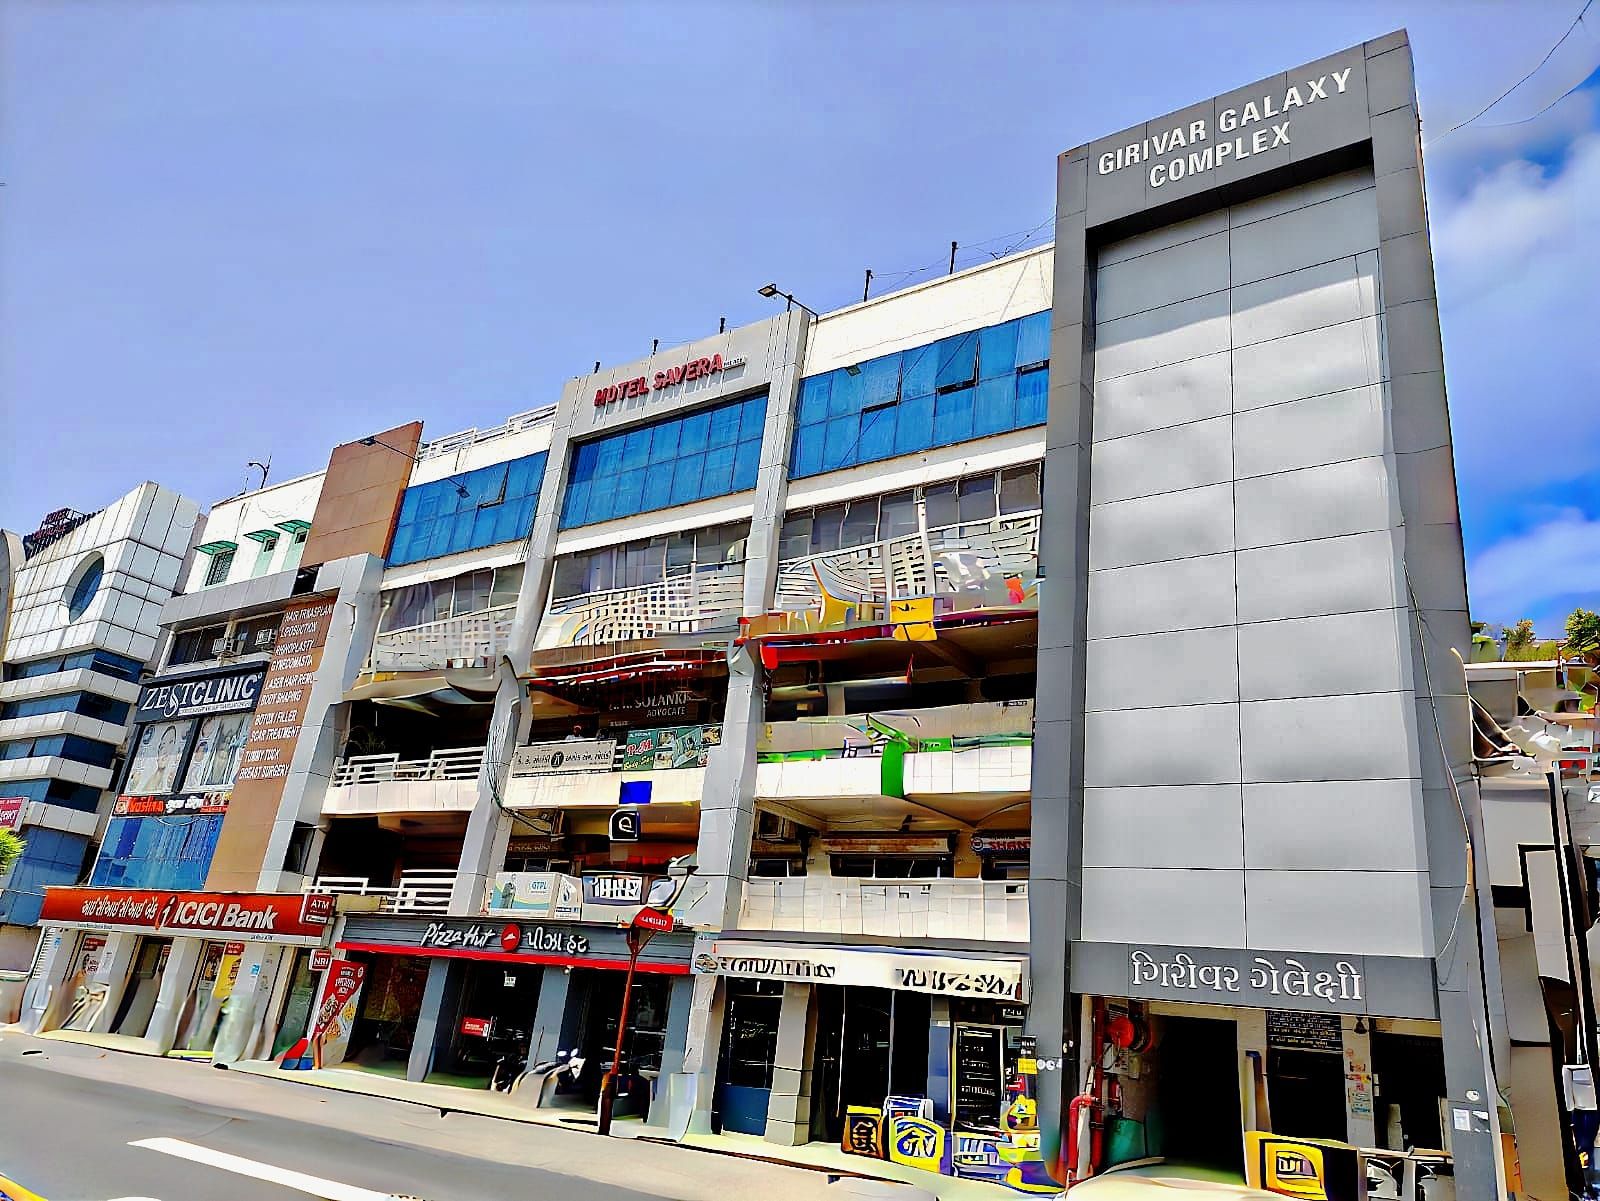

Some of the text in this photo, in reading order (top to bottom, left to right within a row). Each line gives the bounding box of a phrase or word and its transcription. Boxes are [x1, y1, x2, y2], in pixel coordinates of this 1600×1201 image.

[1099, 67, 1352, 175] GIRIVAR GALAXY
[1149, 120, 1291, 188] COMPLEX
[653, 353, 723, 390] SAVERA
[260, 690, 302, 705] BODY SHAPING
[255, 712, 274, 725] BOTOX
[277, 710, 297, 723] FILLER
[647, 706, 685, 718] ADVOCATE
[250, 726, 300, 742] SCAR TREATMENT
[245, 748, 280, 762] TUMMY TUCK
[239, 764, 289, 779] BREAST SURGERY
[531, 880, 547, 890] GTPL
[311, 899, 329, 910] ATM
[173, 901, 279, 929] ICICI Bank
[420, 922, 497, 947] Pizza Hut
[313, 957, 329, 966] NRI
[1131, 950, 1362, 1003] ગિરીવર ગેલેક્ષી
